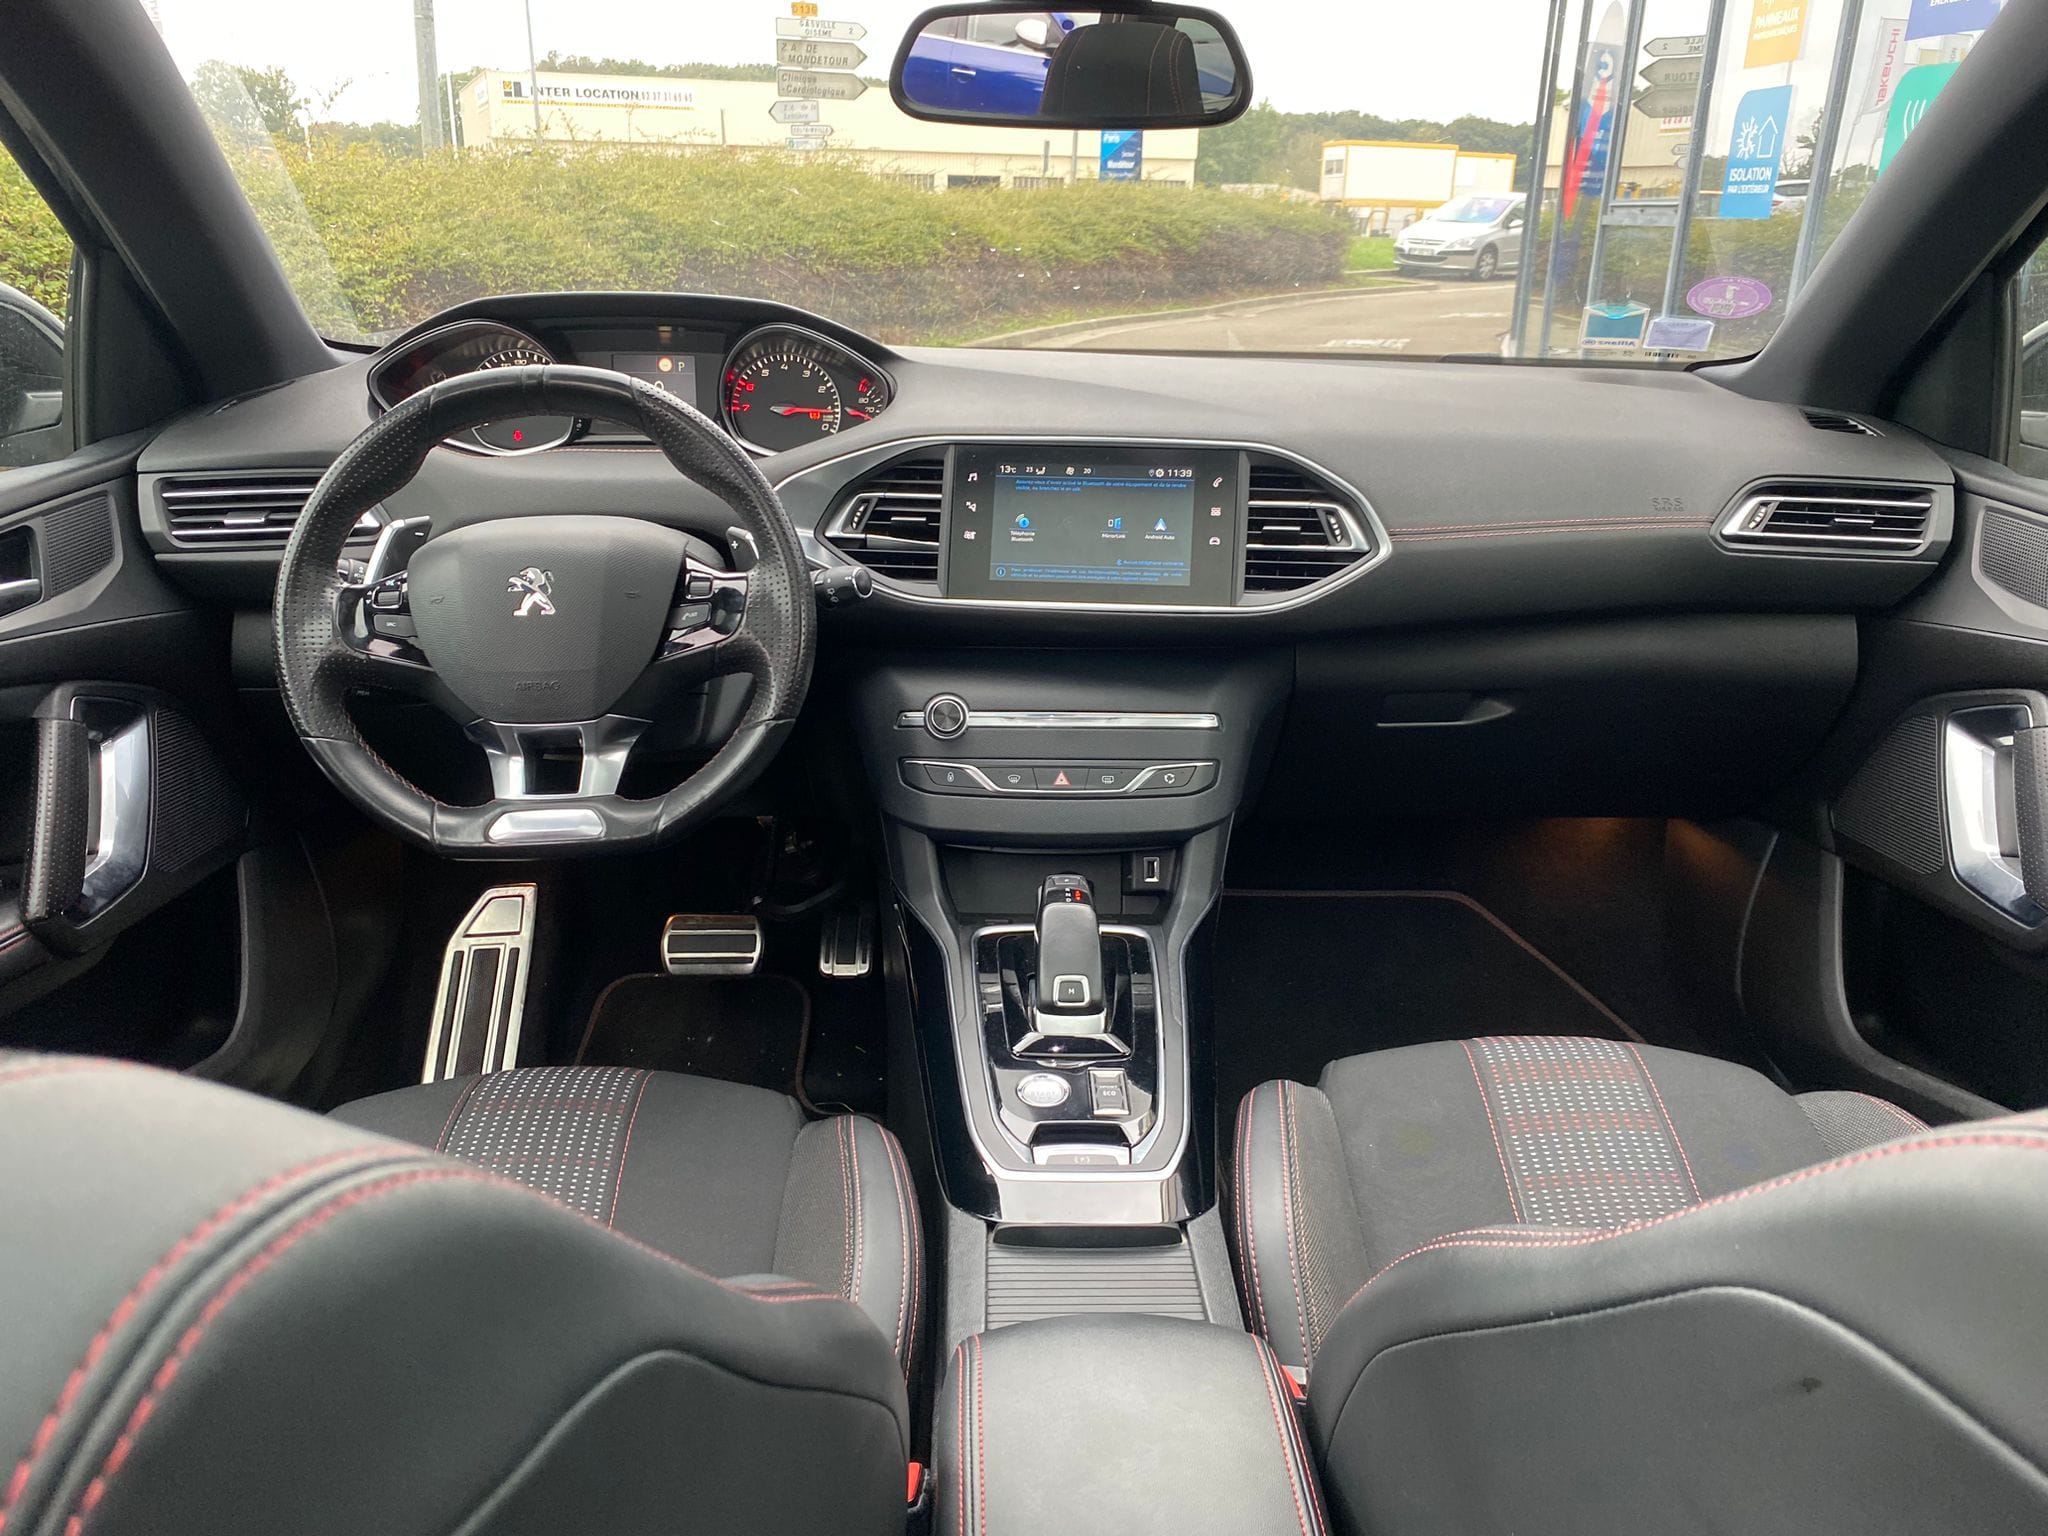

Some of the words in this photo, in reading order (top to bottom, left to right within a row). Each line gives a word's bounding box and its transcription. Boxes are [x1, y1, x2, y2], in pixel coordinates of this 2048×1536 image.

[806, 44, 817, 53] DE
[788, 54, 848, 67] MONDETOUR
[781, 73, 818, 84] Clinique
[576, 88, 639, 101] LOCATION
[1729, 166, 1773, 182] ISOLATION
[678, 362, 685, 371] P
[761, 369, 770, 377] 5
[802, 370, 810, 378] 3
[514, 681, 560, 692] AIRBAG
